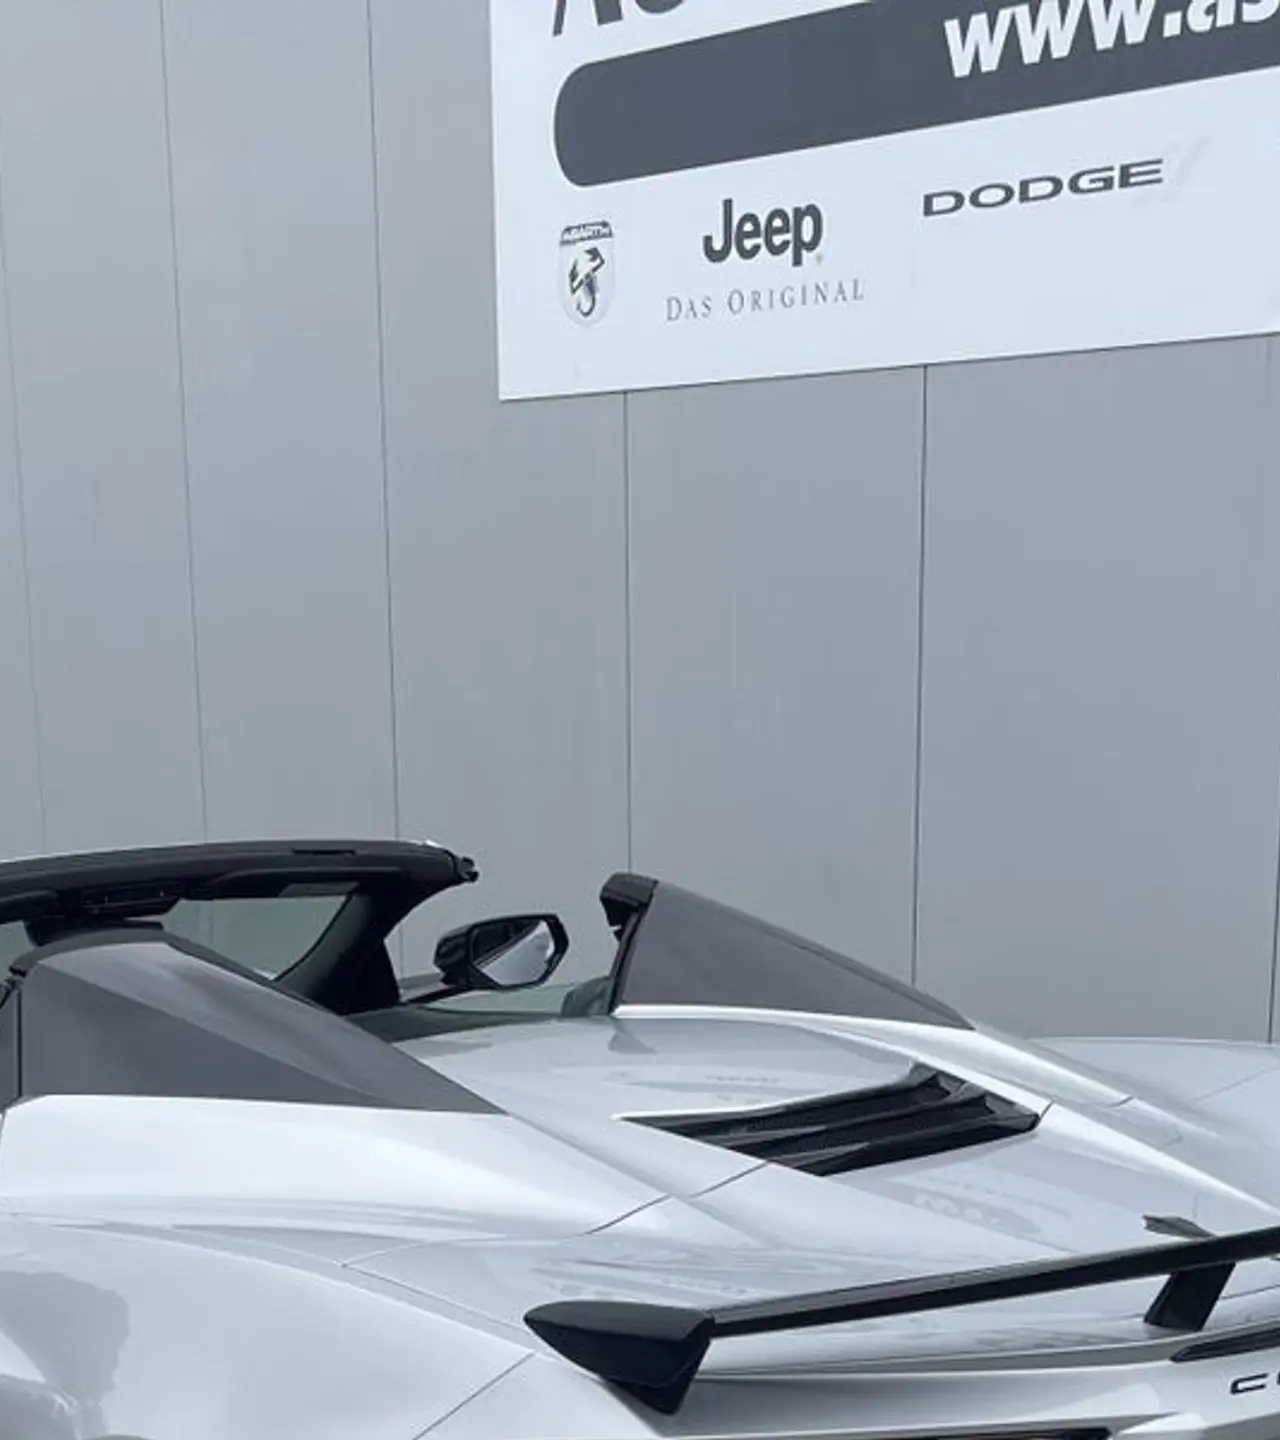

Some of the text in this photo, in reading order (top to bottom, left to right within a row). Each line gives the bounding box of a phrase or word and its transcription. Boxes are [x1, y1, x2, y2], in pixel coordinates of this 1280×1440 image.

[923, 158, 1164, 217] DODGE
[703, 198, 821, 267] Jeep
[666, 278, 865, 322] DAS ORIGINAL
